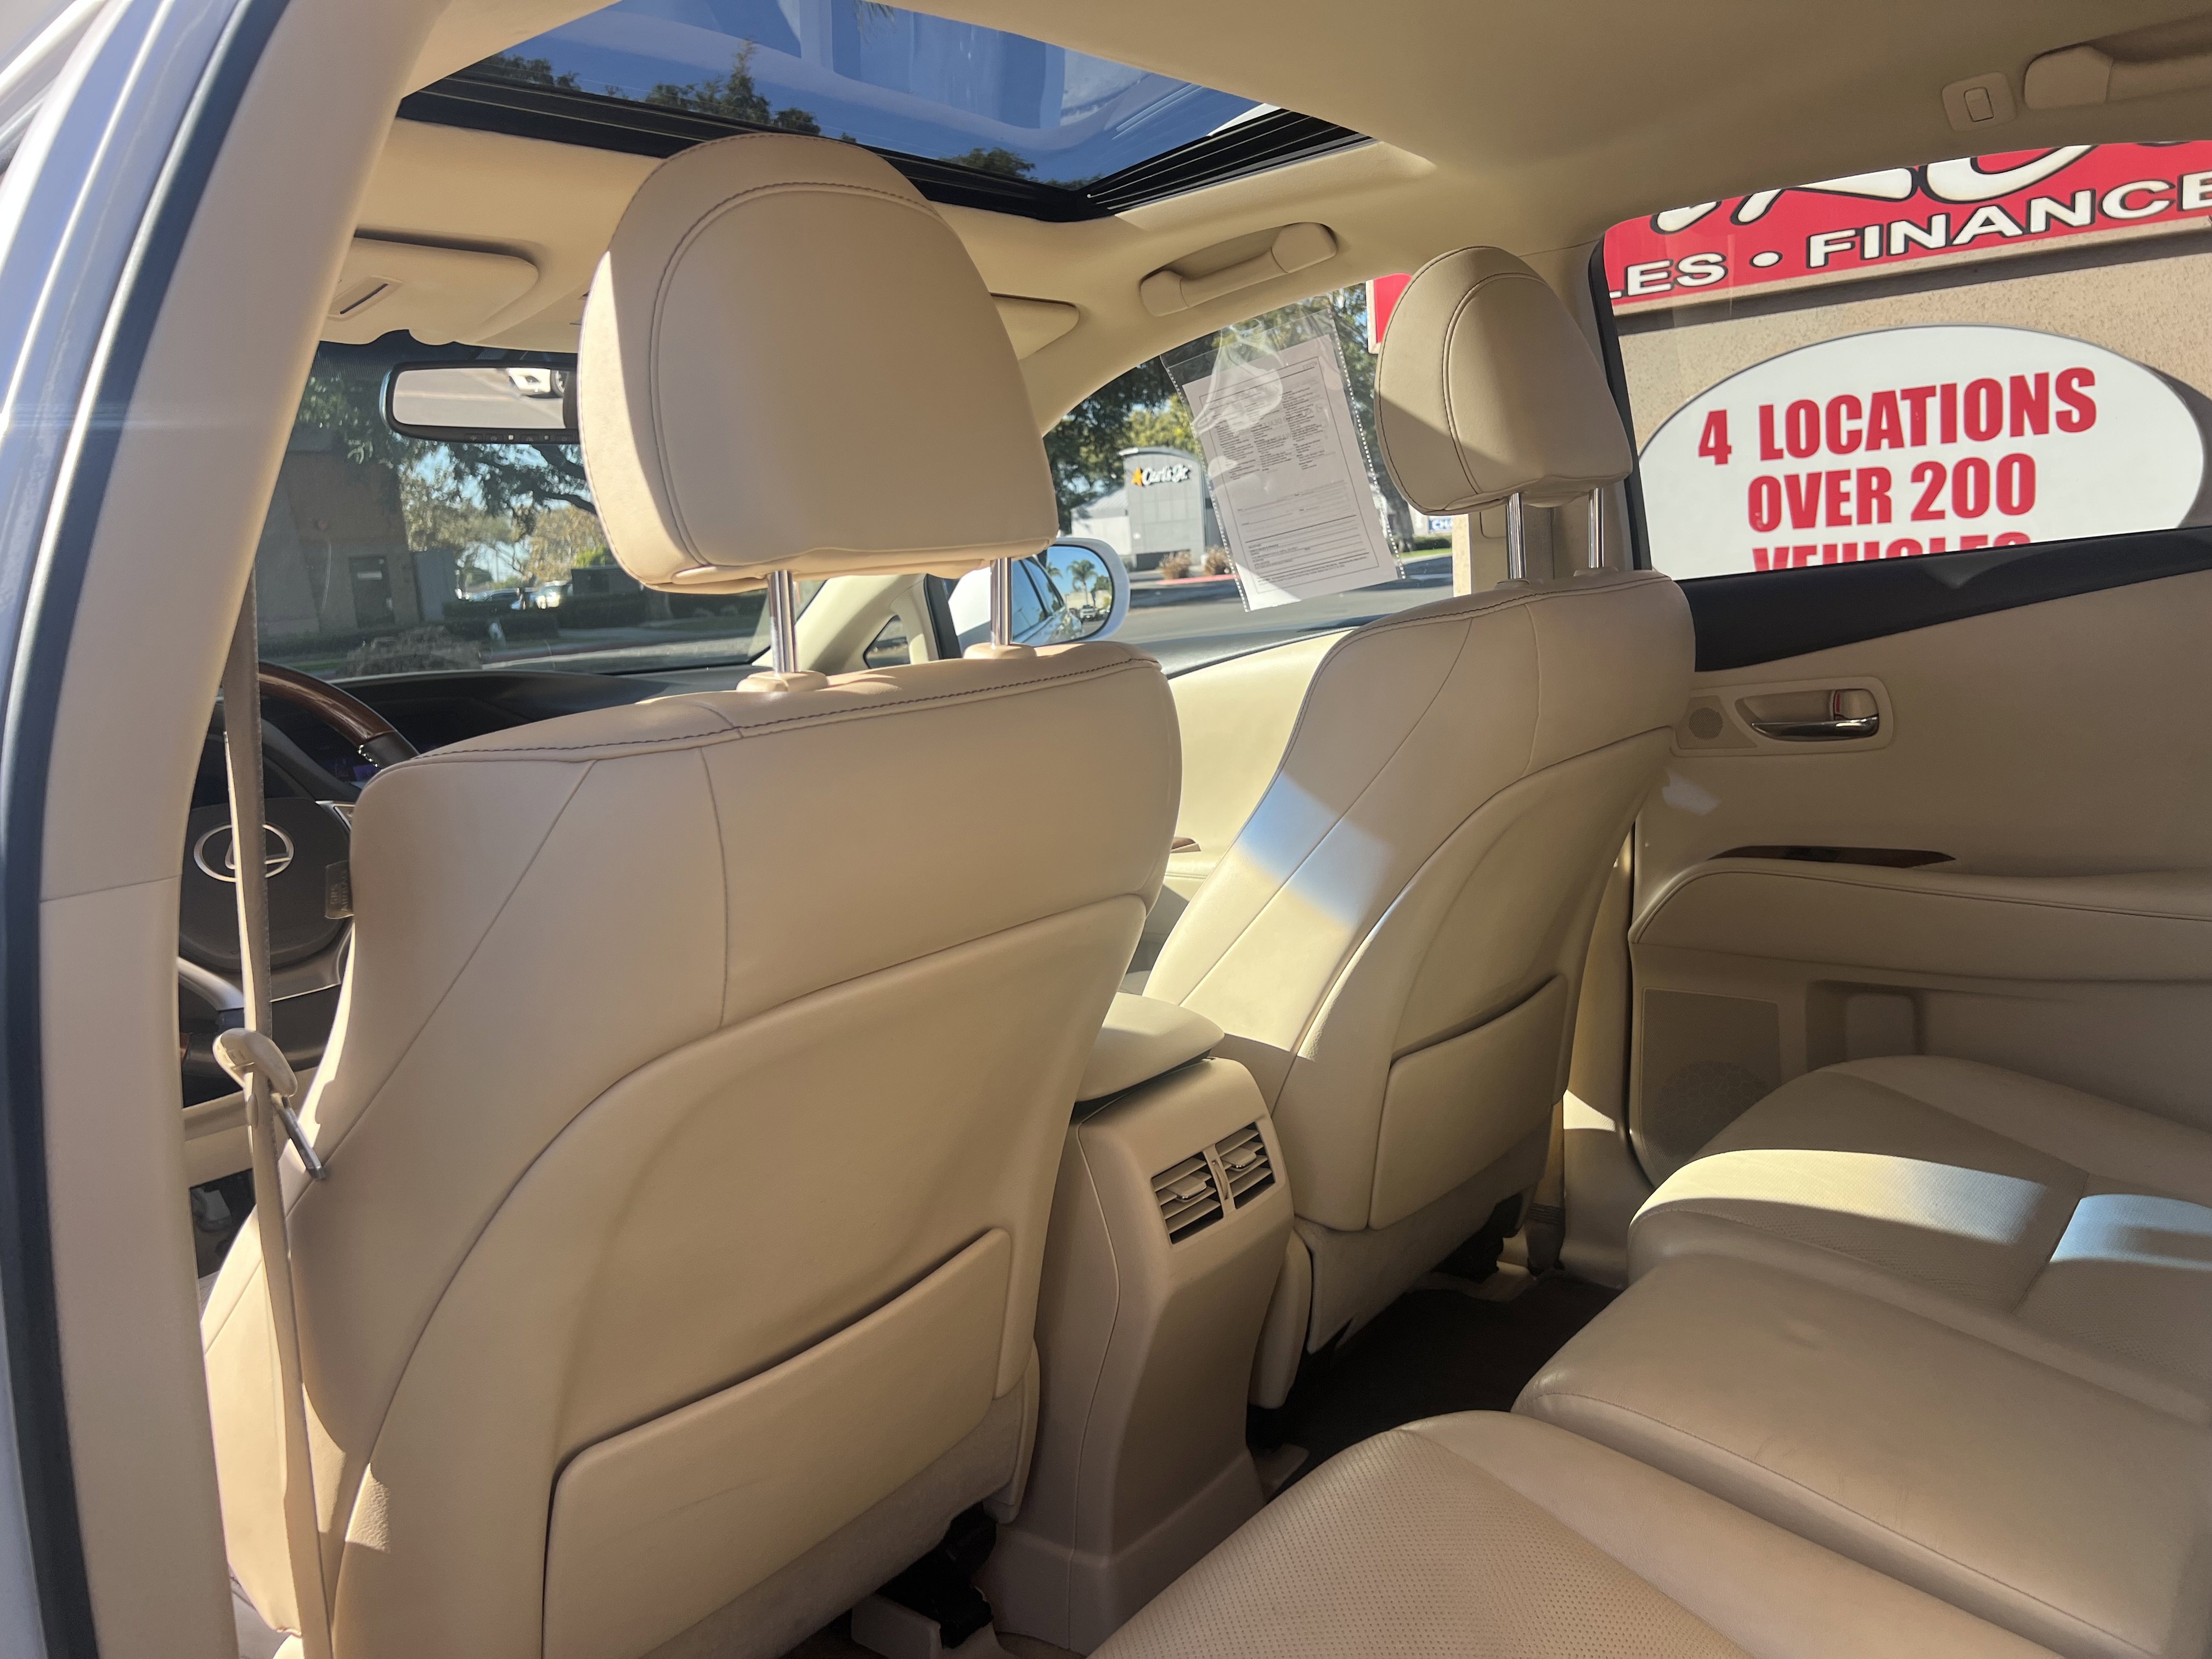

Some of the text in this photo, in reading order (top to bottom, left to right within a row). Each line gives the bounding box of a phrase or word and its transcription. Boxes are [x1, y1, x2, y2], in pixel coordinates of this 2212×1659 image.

[1608, 252, 1726, 300] ES
[1699, 368, 2096, 465] 4 LOCATIONS
[1748, 453, 2035, 532] OVER 200
